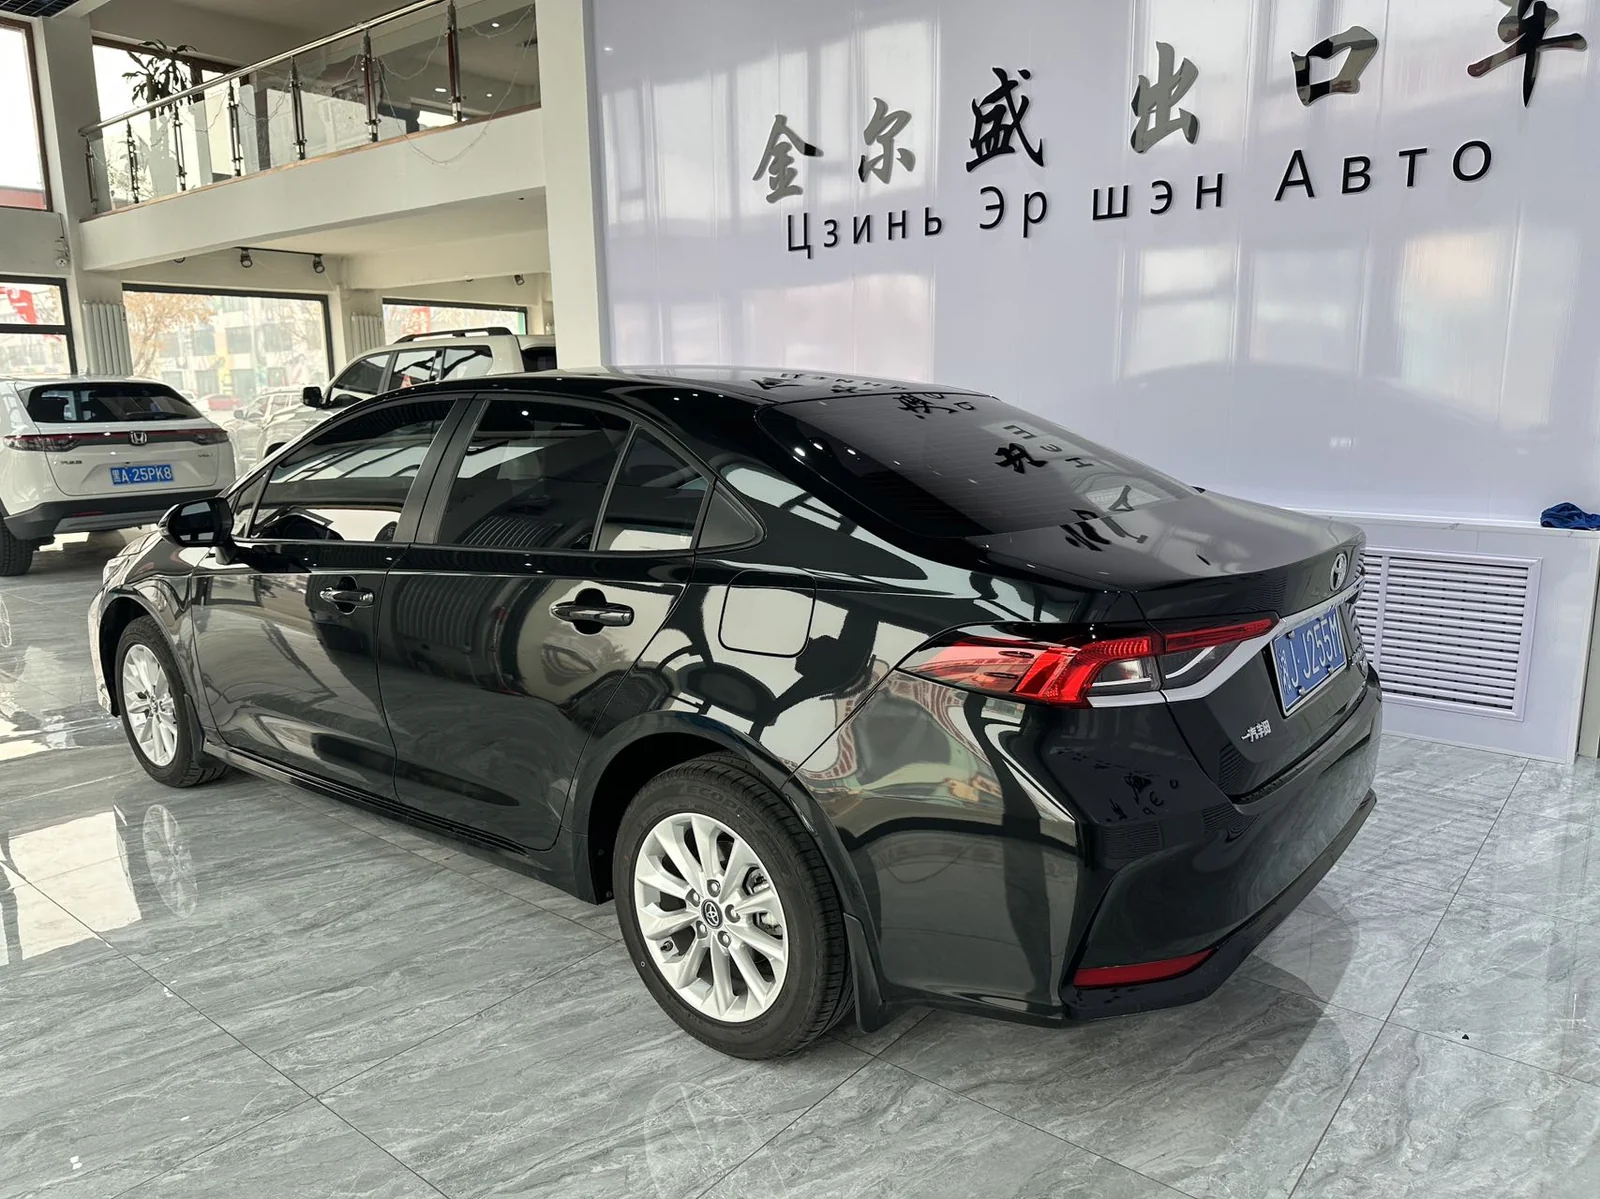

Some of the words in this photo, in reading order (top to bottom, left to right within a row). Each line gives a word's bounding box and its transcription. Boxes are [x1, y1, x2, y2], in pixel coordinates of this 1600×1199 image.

[787, 207, 943, 260] Цзинь
[979, 186, 1048, 238] Эр
[1092, 173, 1224, 221] шэн
[1274, 139, 1493, 202] Авто
